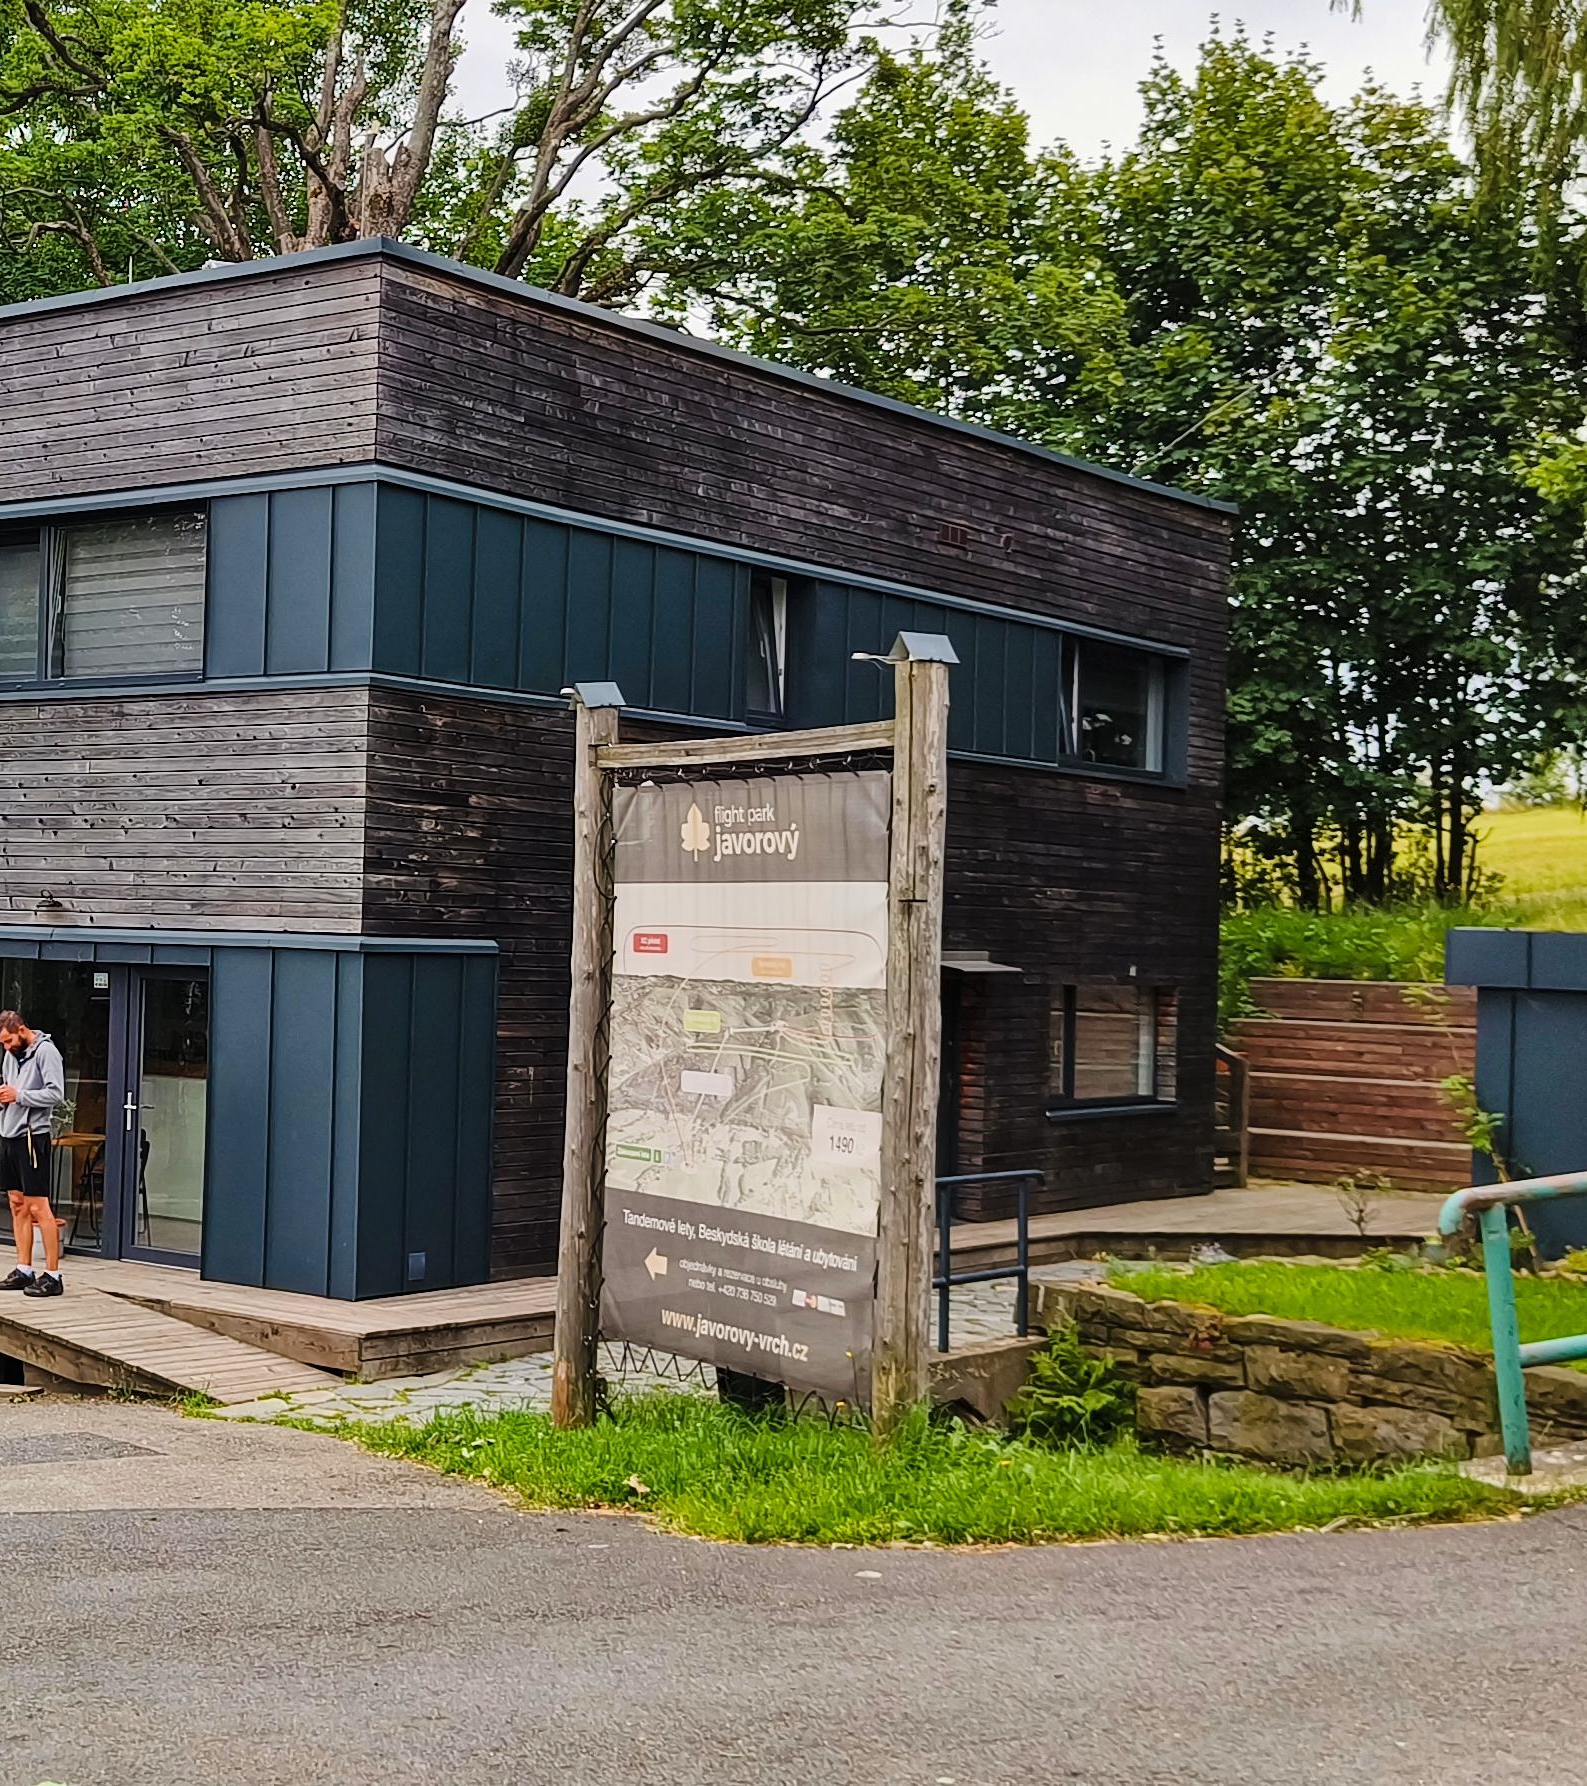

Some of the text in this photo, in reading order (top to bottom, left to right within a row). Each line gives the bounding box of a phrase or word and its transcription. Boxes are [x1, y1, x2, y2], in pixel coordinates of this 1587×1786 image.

[714, 803, 774, 827] flight park
[714, 823, 800, 862] javorový
[829, 1135, 854, 1154] 1490
[622, 1209, 675, 1233] Tandemové
[677, 1220, 696, 1240] lety,
[698, 1223, 750, 1249] Beskydská
[751, 1233, 776, 1254] škola
[804, 1248, 811, 1262] a
[812, 1247, 859, 1272] ubytování
[661, 1308, 810, 1362] www.javorovy-vrch.cz
